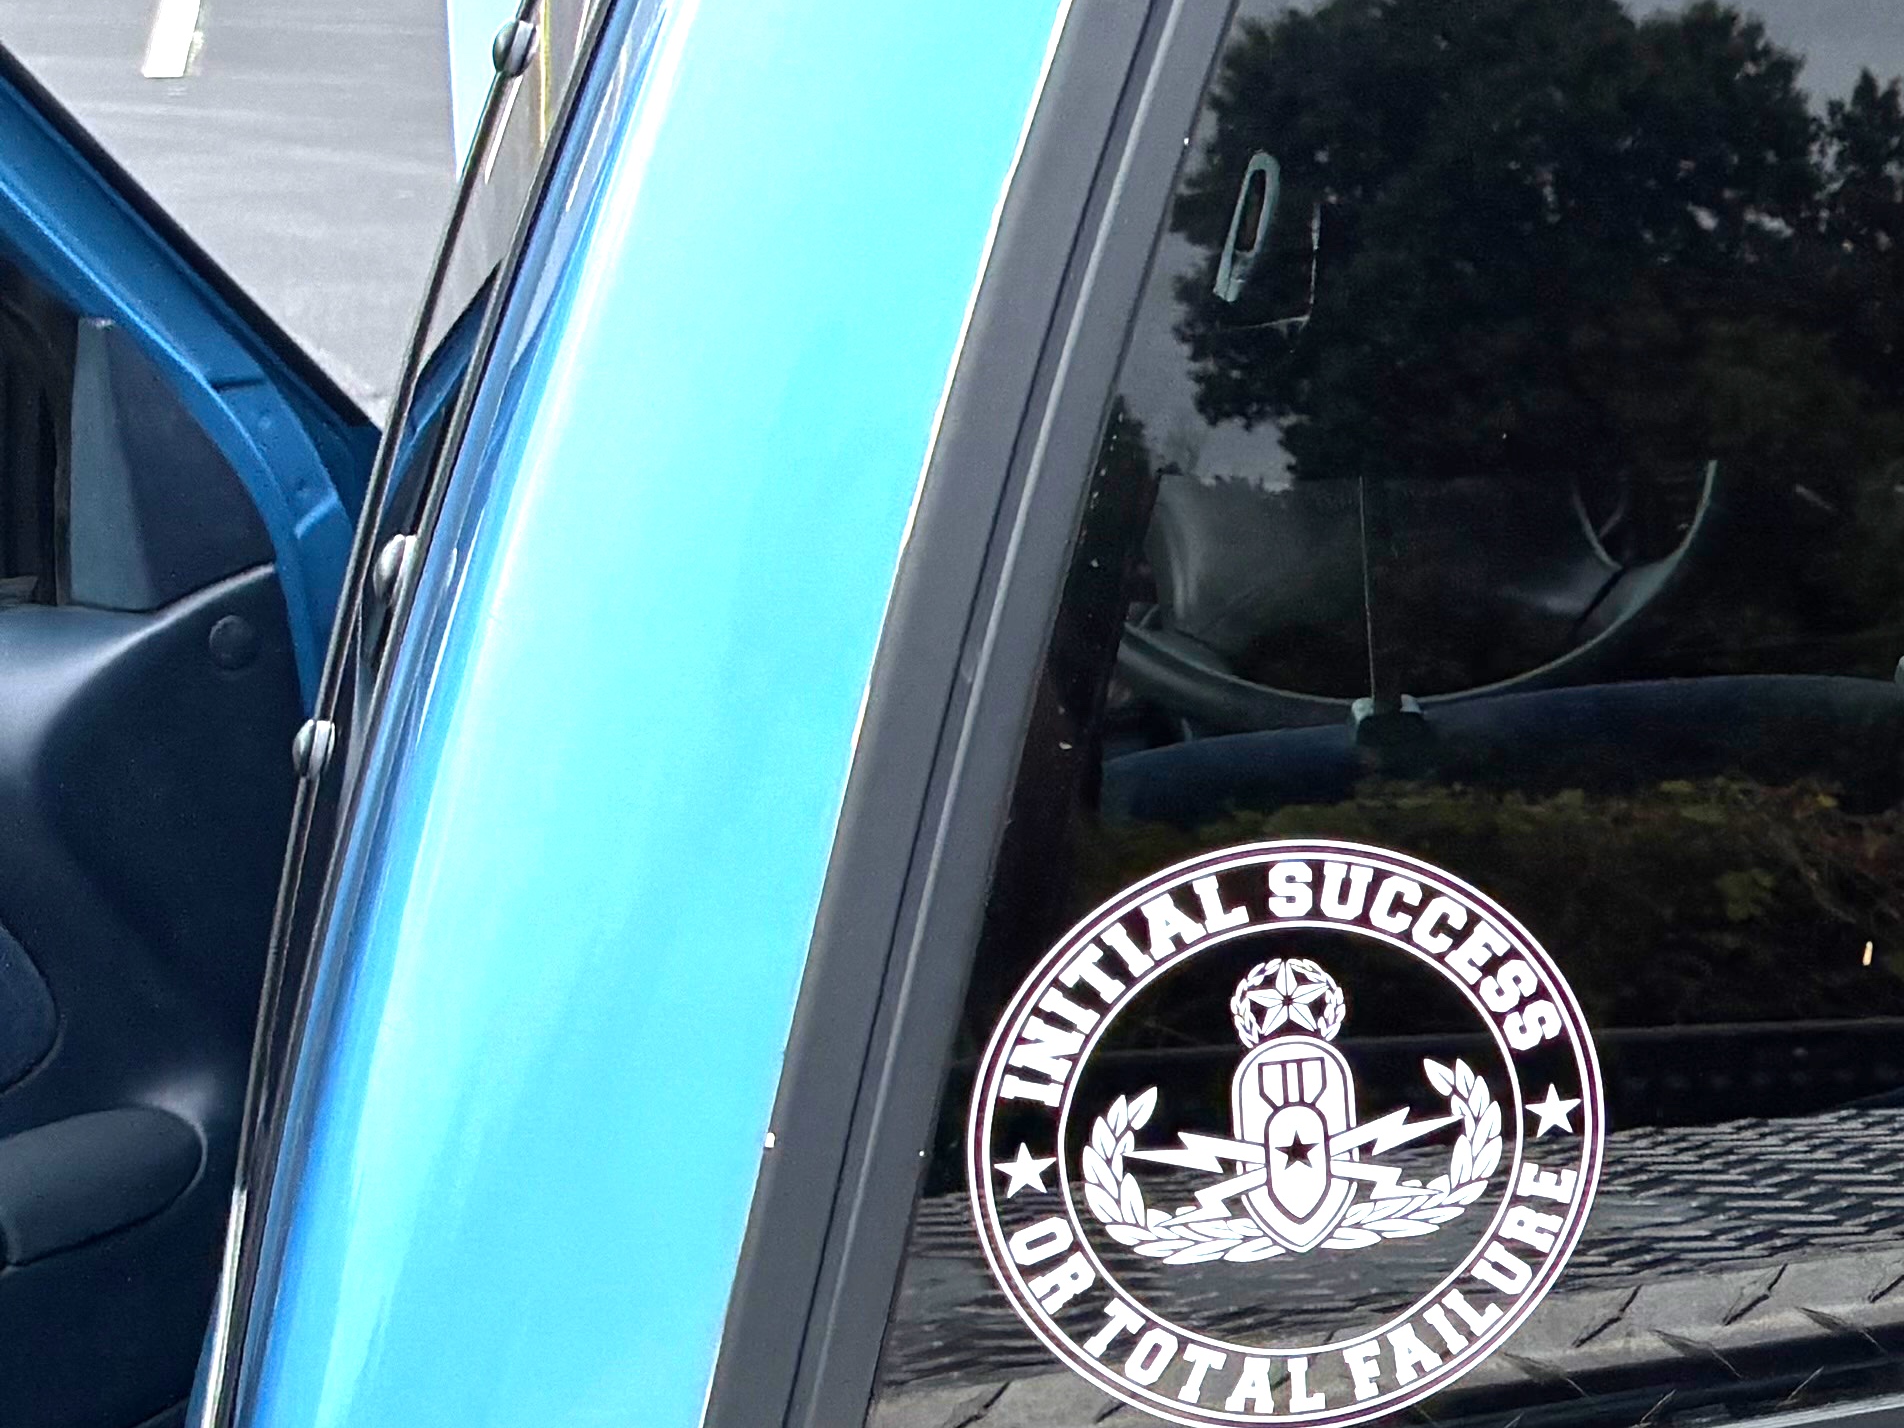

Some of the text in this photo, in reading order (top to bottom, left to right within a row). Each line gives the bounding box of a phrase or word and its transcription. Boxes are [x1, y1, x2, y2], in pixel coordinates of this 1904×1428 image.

[1000, 860, 1562, 1109] INITIAL SUCCESS
[1009, 1161, 1579, 1414] OR TOTAL FAILURE
